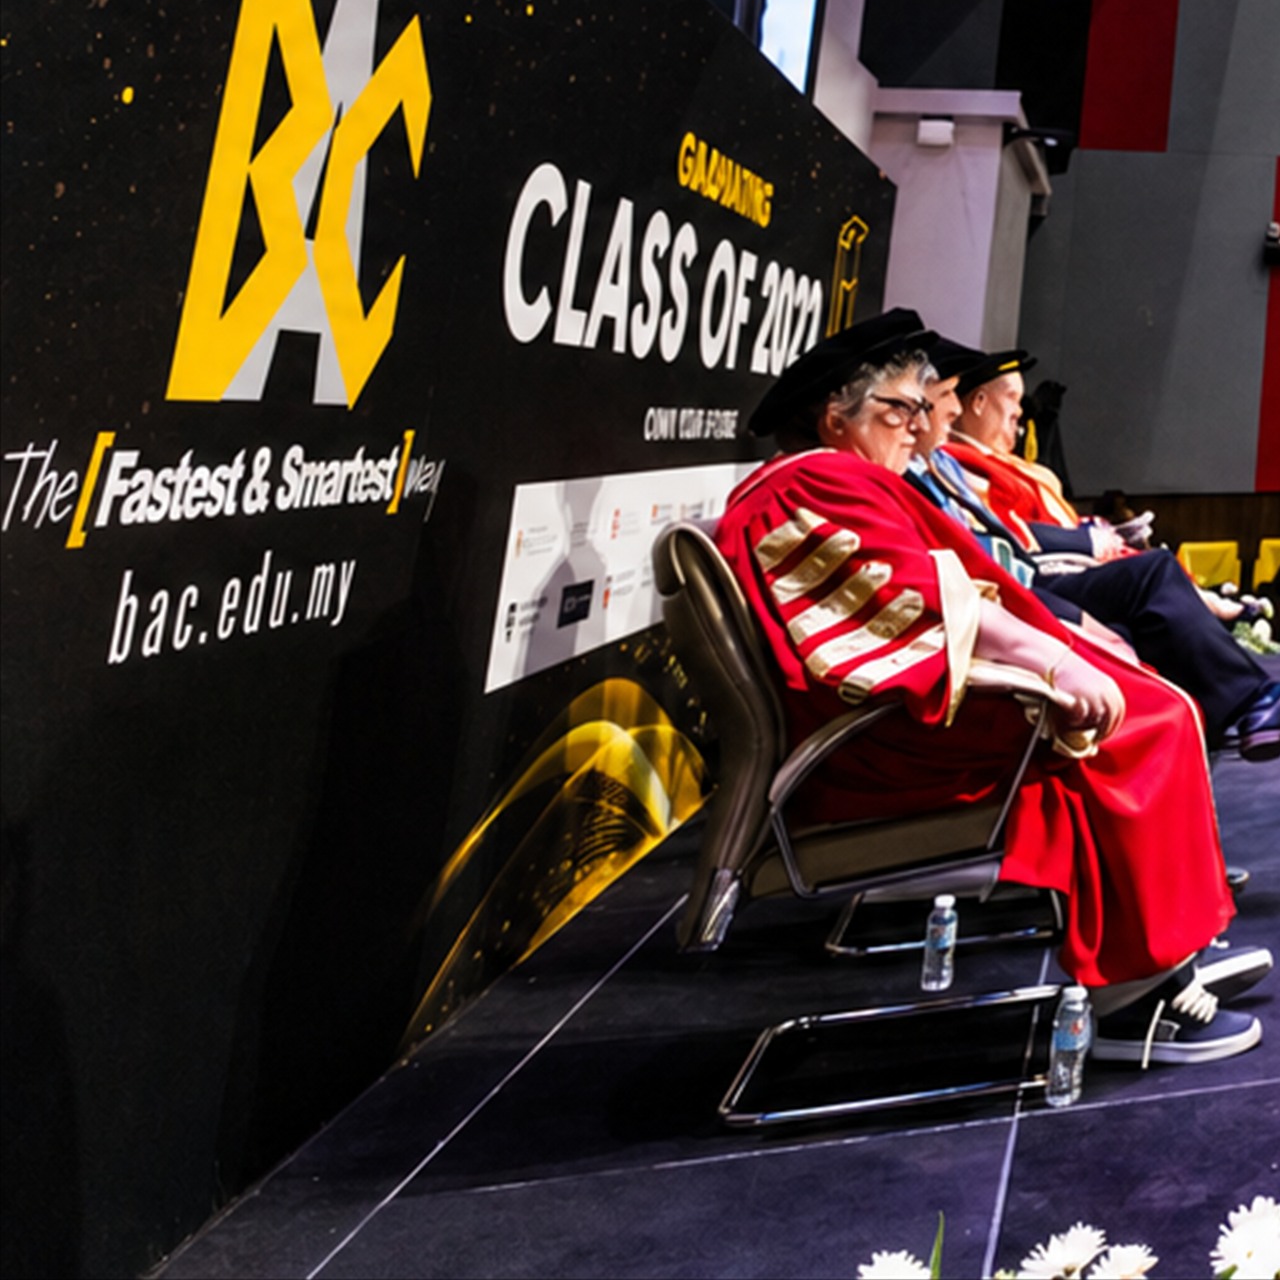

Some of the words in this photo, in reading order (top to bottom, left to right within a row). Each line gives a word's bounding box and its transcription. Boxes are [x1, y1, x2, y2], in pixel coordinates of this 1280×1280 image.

[503, 162, 698, 363] CLASS
[700, 238, 758, 370] OF
[2, 439, 79, 531] The
[243, 445, 272, 513] &
[108, 549, 357, 665] bac.edu.my
